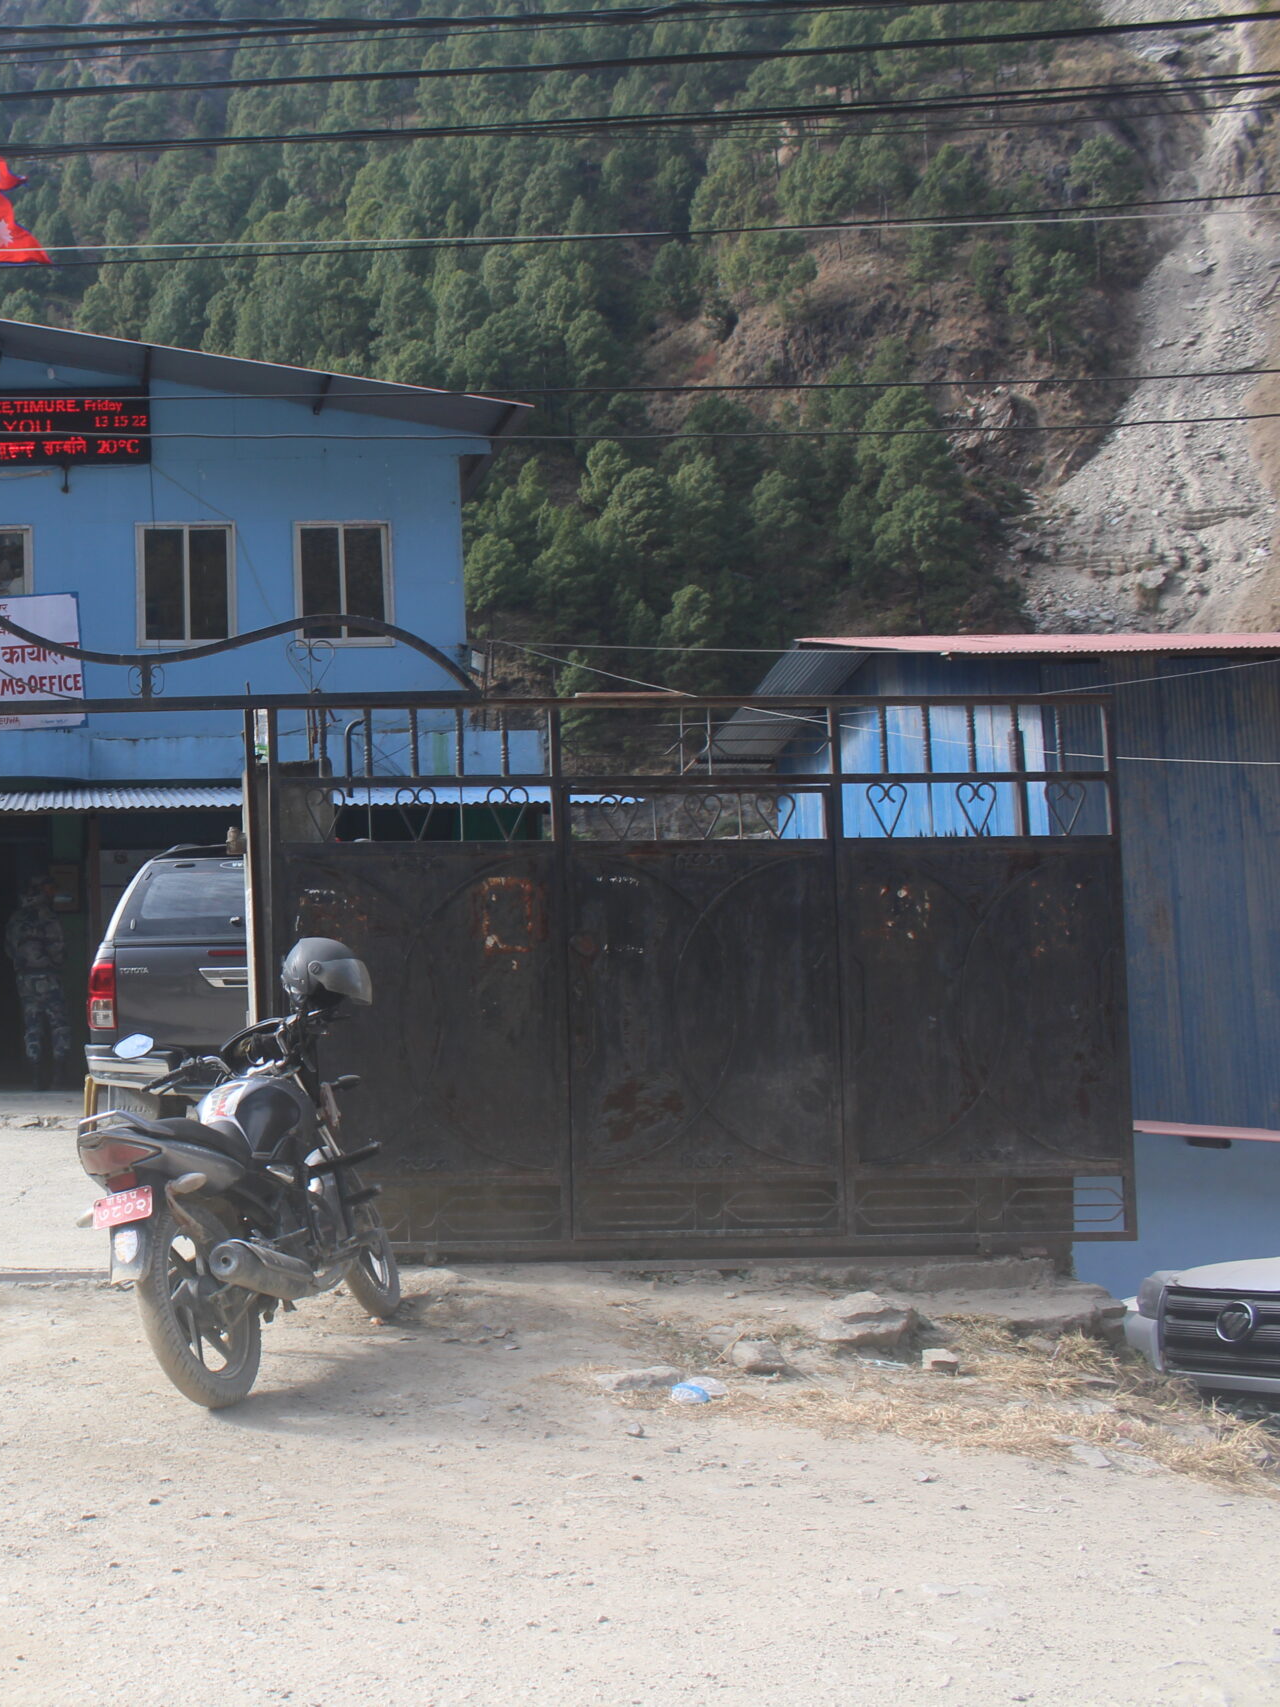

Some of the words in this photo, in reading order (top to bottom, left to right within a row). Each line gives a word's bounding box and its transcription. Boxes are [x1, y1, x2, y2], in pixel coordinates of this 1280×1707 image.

[84, 400, 123, 412] Friday
[2, 419, 52, 434] YOU
[28, 674, 82, 694] OFFICE
